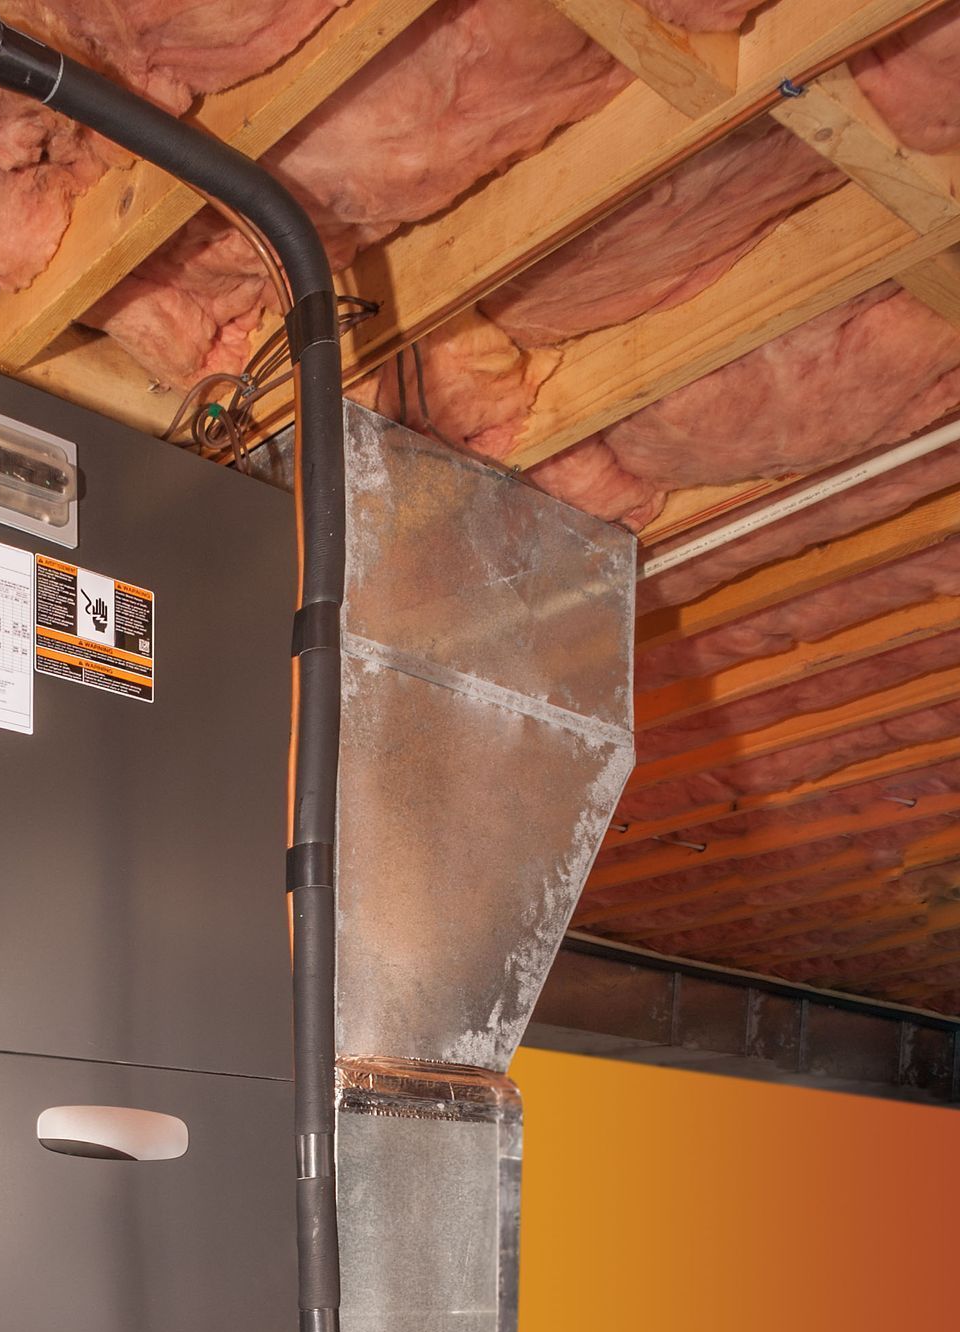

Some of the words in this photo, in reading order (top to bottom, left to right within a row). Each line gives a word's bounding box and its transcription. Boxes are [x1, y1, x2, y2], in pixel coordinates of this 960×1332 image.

[123, 585, 151, 598] WARNING
[85, 641, 113, 655] WARNING
[85, 661, 113, 675] WARNING
